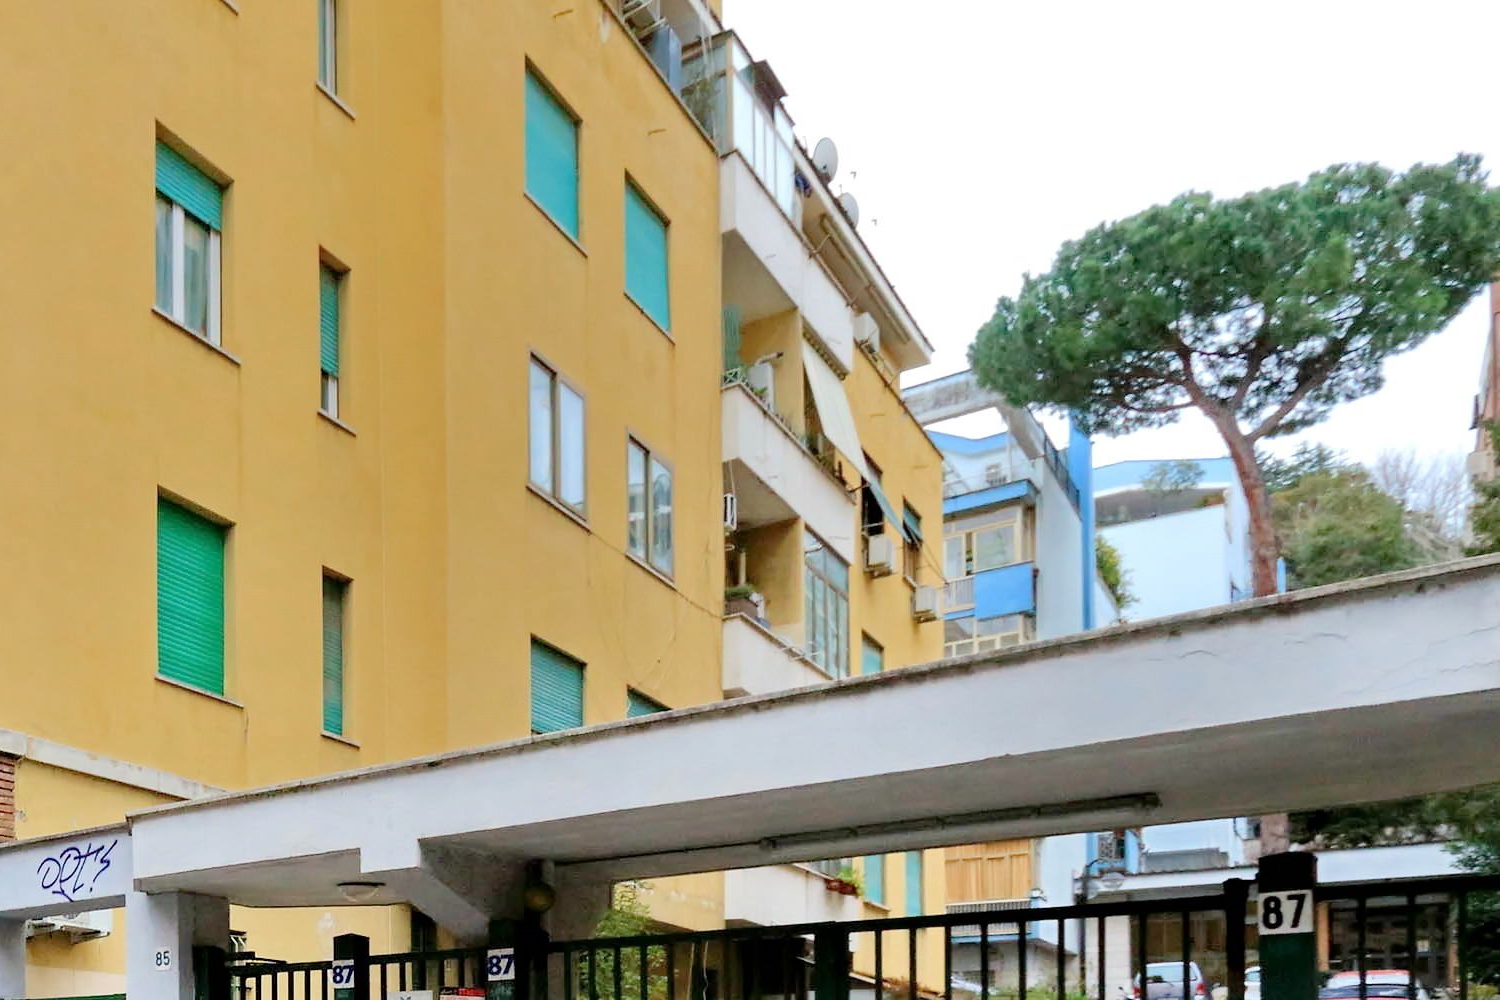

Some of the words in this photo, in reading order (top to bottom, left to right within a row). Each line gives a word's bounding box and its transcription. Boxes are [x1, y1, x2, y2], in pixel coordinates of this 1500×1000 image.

[1262, 893, 1308, 930] 87
[155, 950, 171, 967] 85
[487, 955, 515, 976] 87
[332, 965, 355, 984] 87
